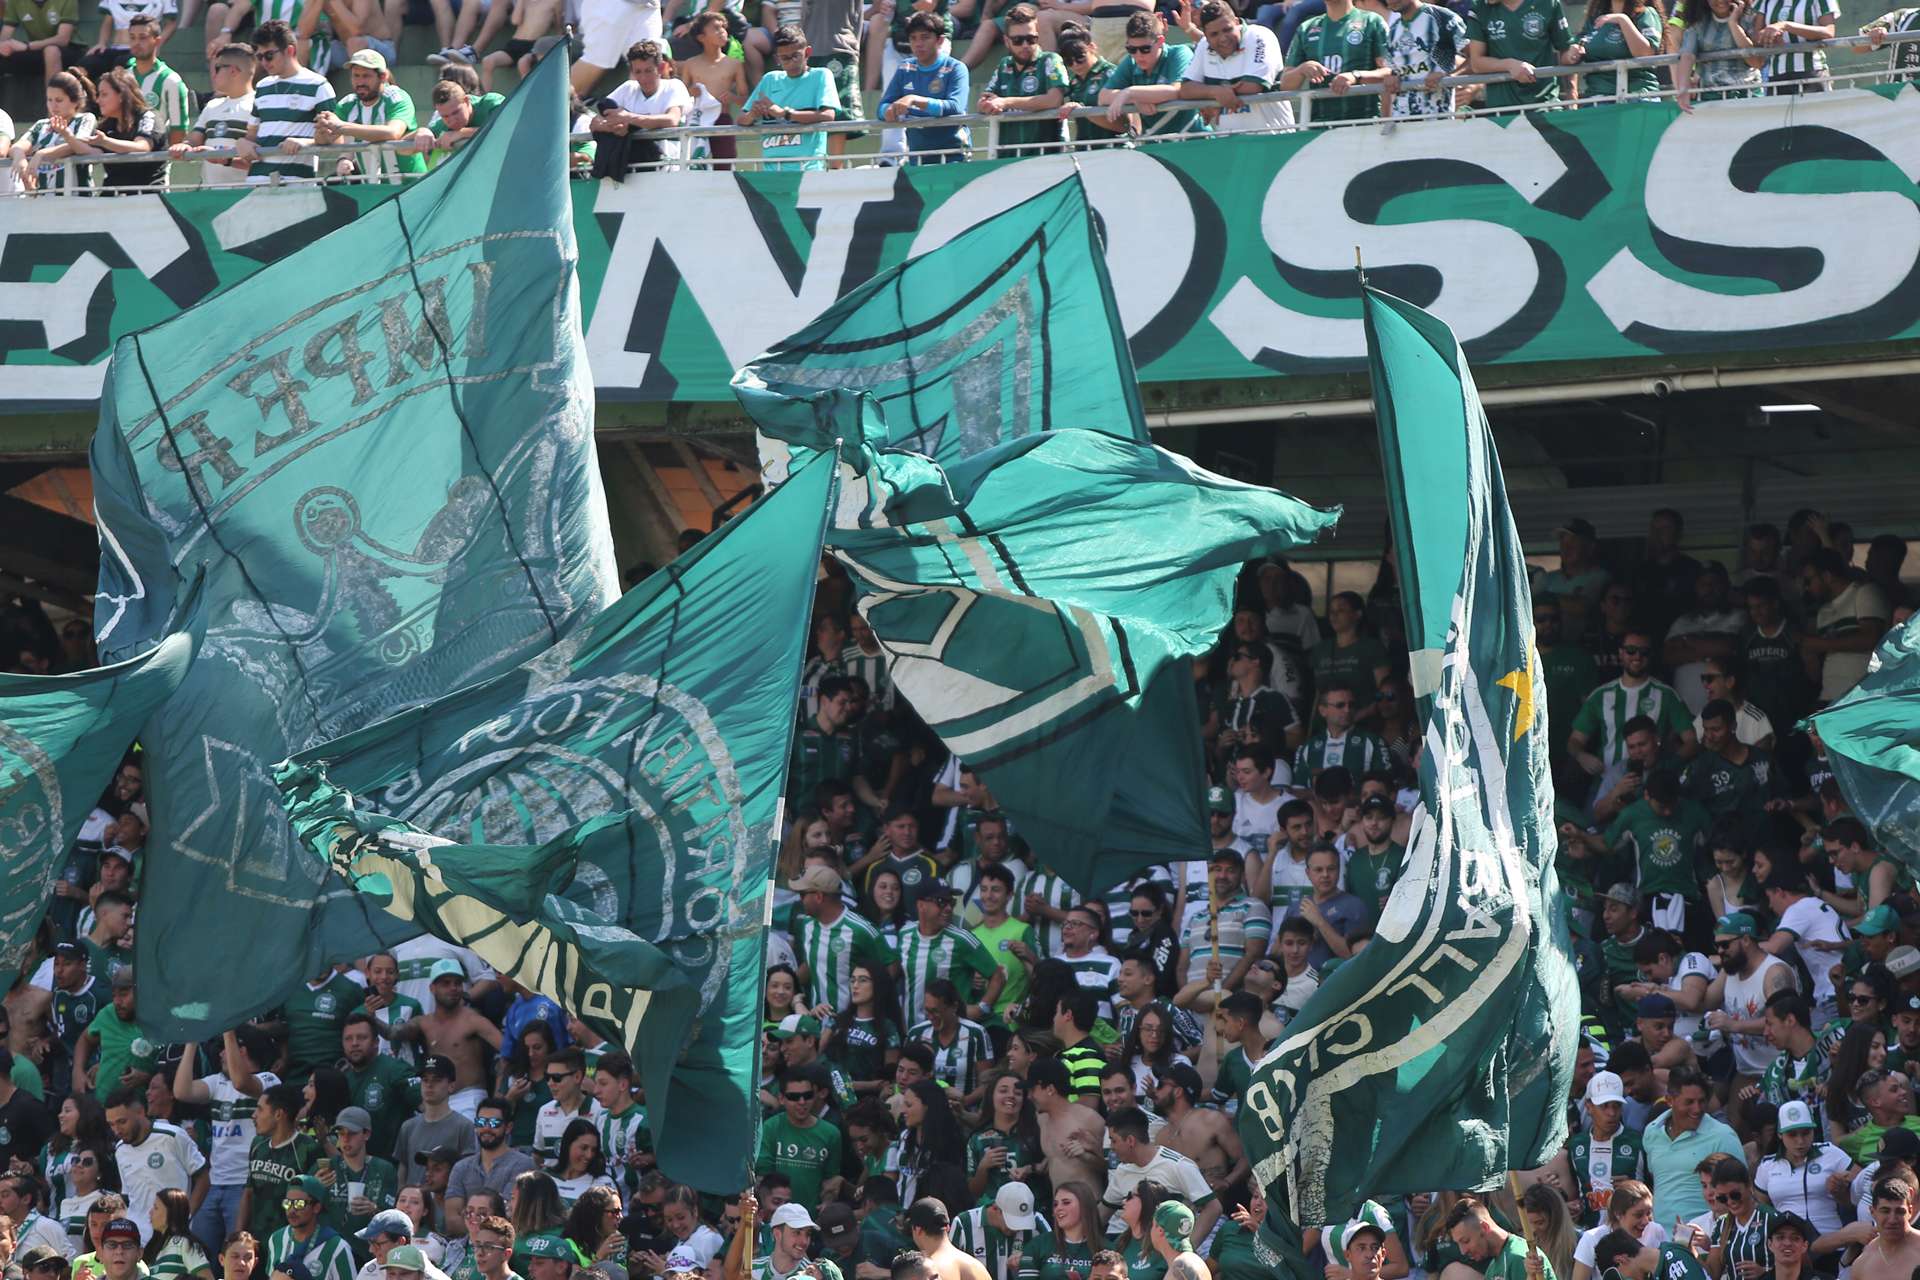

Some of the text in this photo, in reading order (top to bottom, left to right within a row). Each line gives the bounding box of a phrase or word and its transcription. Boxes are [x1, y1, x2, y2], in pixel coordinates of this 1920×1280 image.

[1323, 55, 1342, 74] 10
[1711, 770, 1730, 787] 39
[1386, 848, 1503, 1005] BALL
